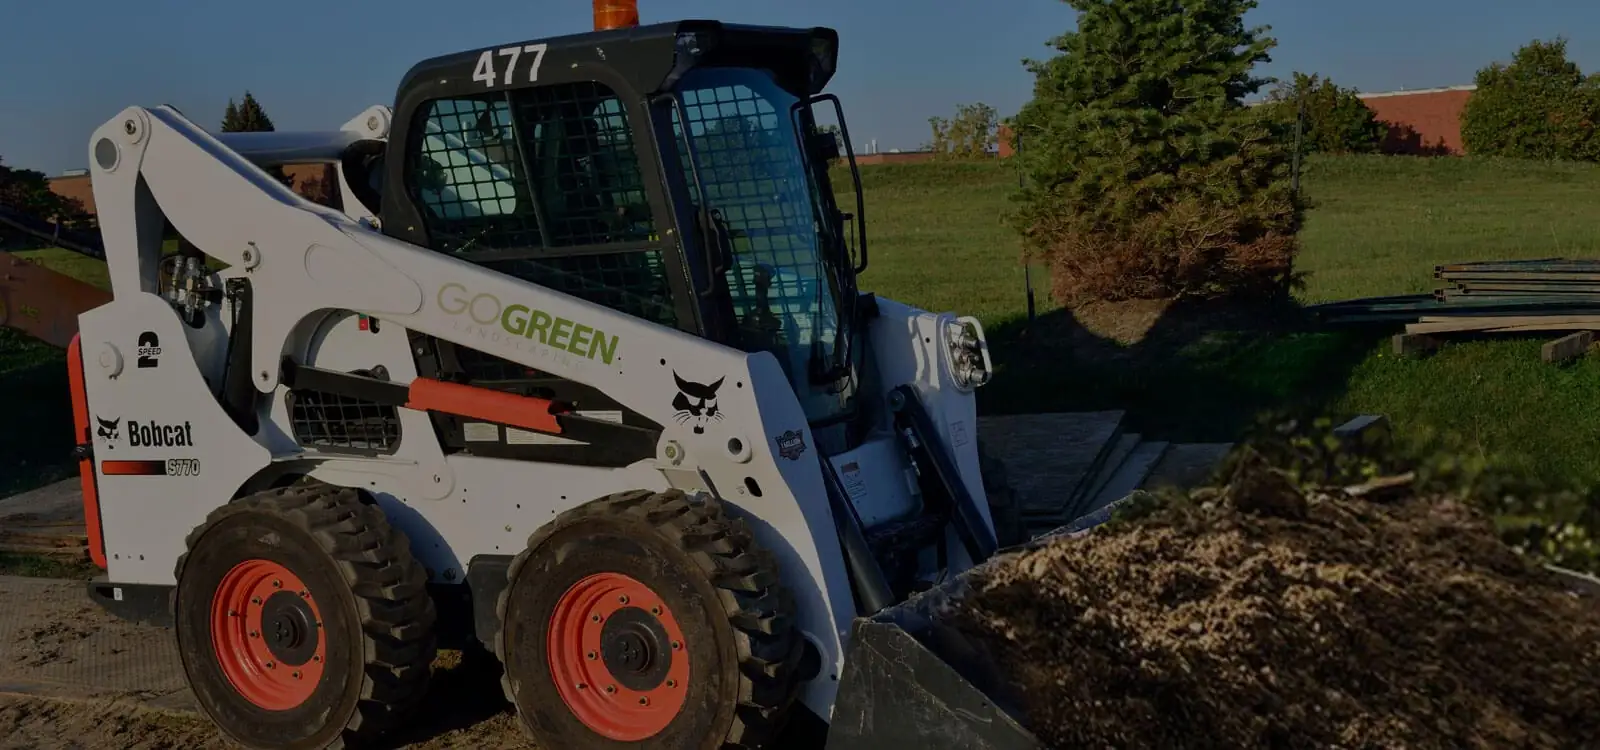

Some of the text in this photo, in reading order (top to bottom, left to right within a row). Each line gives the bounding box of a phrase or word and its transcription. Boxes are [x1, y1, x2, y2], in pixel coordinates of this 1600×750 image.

[472, 43, 547, 88] 477
[138, 331, 159, 368] 2
[138, 347, 162, 356] SPEED
[127, 420, 193, 447] Bobcat
[168, 458, 201, 477] S770
